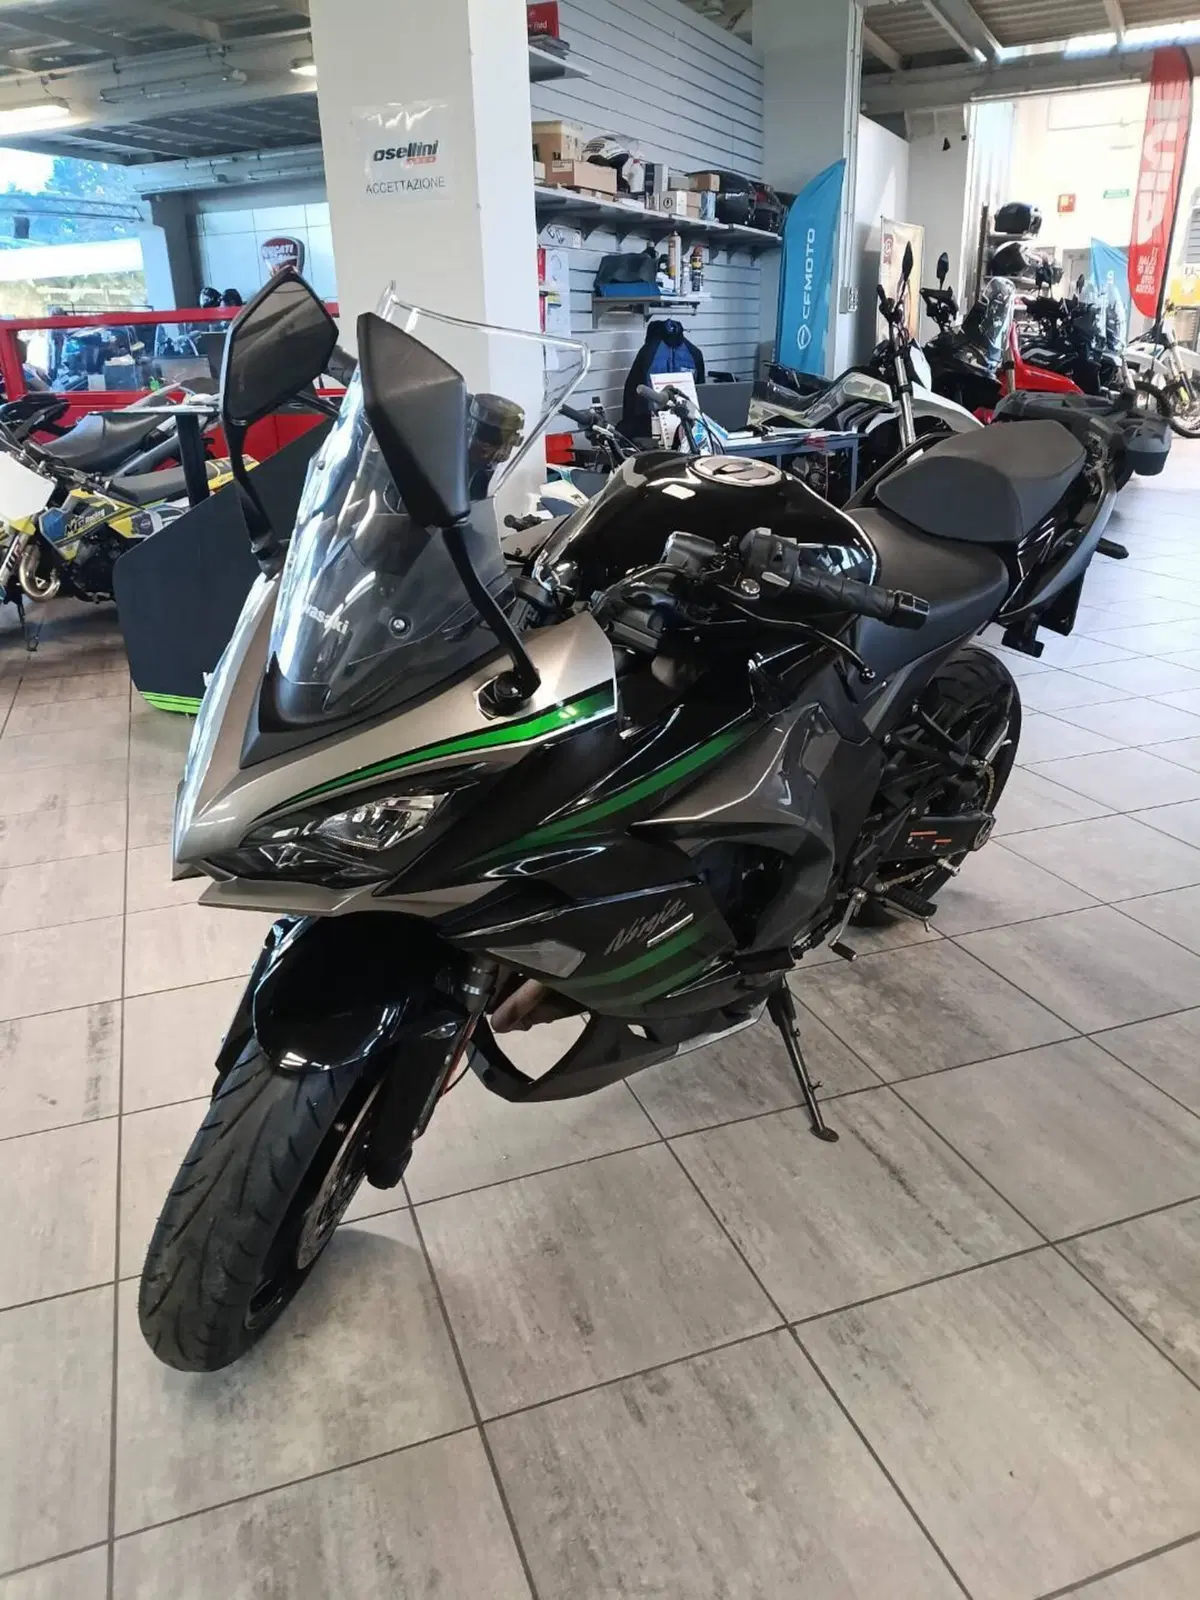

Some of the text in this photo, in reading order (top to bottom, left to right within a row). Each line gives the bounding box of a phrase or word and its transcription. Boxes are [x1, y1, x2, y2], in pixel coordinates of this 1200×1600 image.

[366, 177, 446, 195] ACCETTAZIONE
[802, 228, 815, 320] CFMOTO
[603, 898, 686, 956] Ninja
